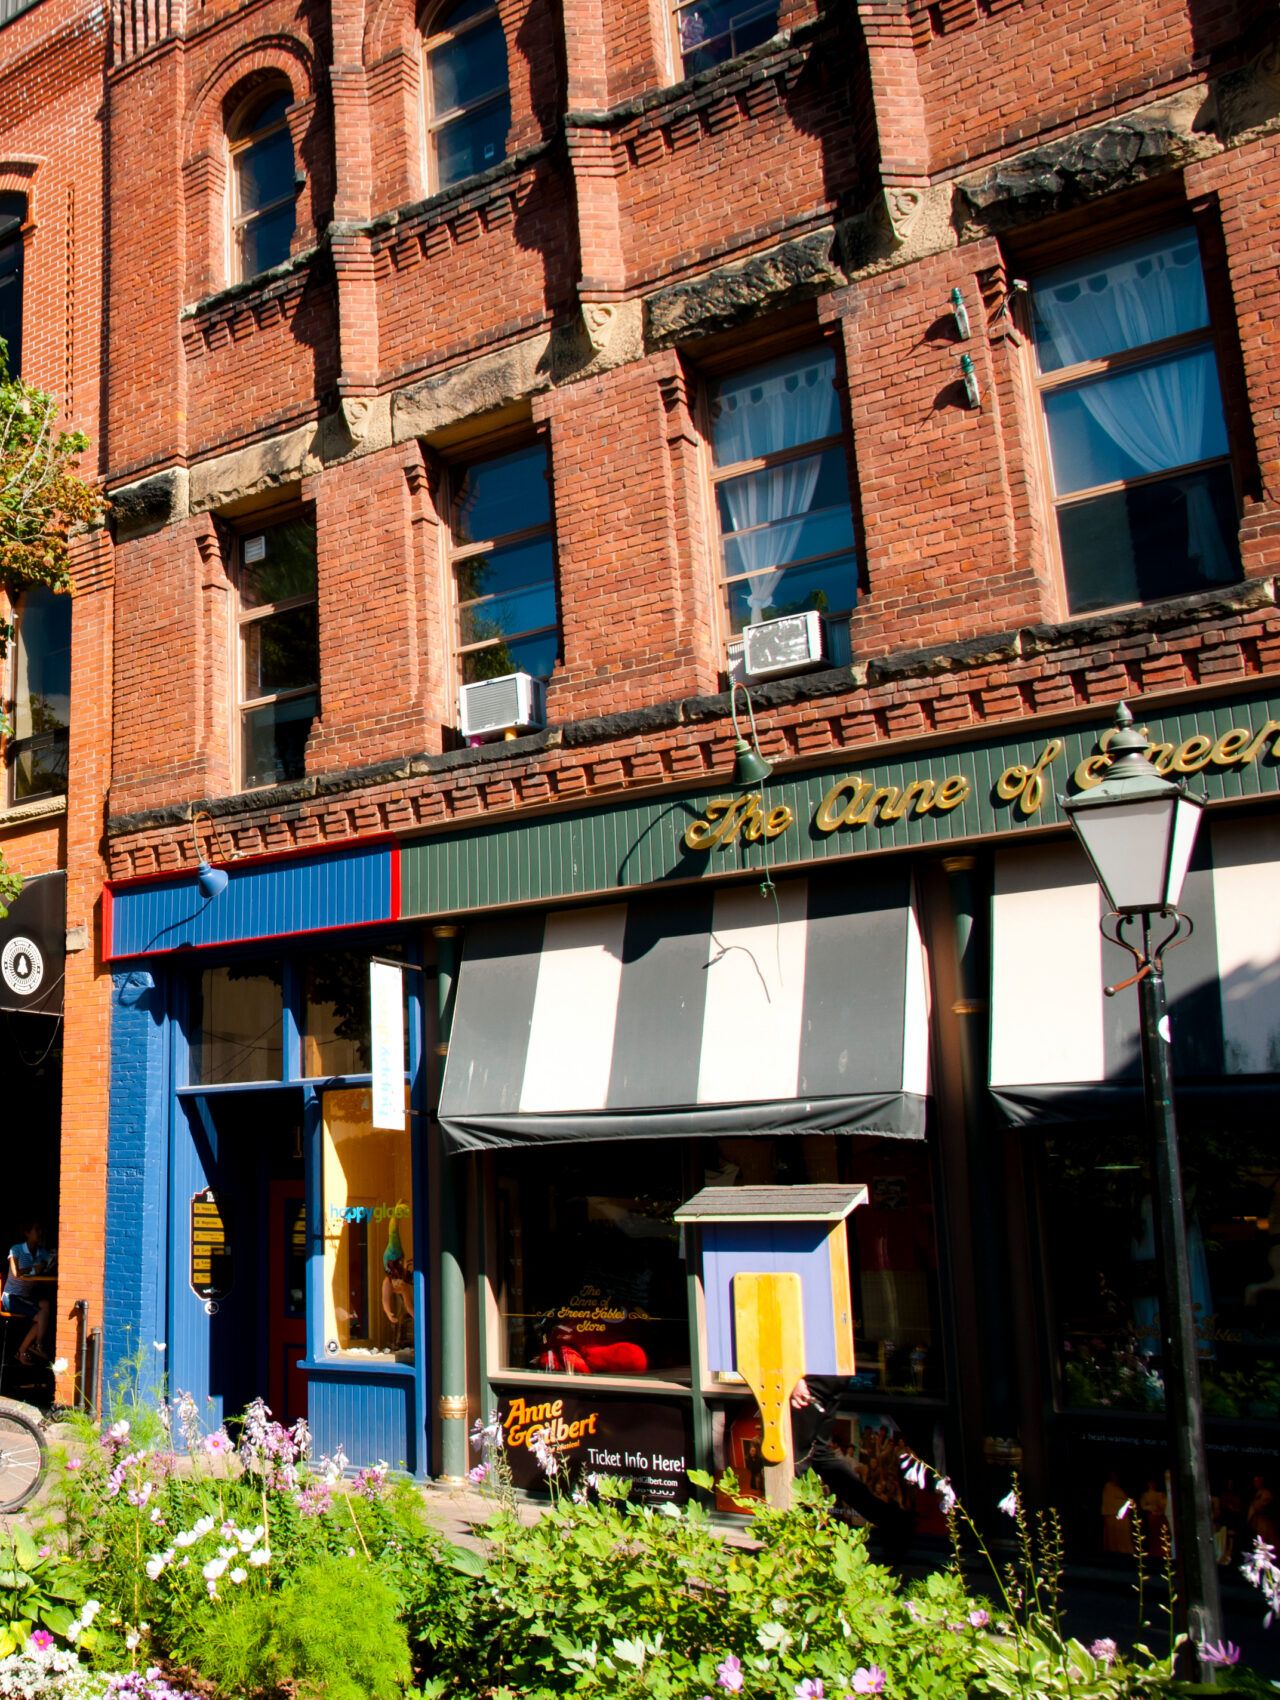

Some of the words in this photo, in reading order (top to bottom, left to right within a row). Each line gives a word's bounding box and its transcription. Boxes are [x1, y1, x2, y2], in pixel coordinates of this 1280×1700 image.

[684, 793, 793, 851] The
[816, 775, 972, 833] Anne
[996, 739, 1064, 815] of
[579, 1284, 601, 1297] The
[569, 1296, 598, 1307] Anne
[557, 1306, 591, 1319] Green
[591, 1306, 626, 1320] Gables
[576, 1320, 607, 1333] Store
[503, 1398, 564, 1429] Anne
[587, 1448, 622, 1467] Ticket
[624, 1451, 648, 1470] Info
[652, 1454, 686, 1473] Here!
